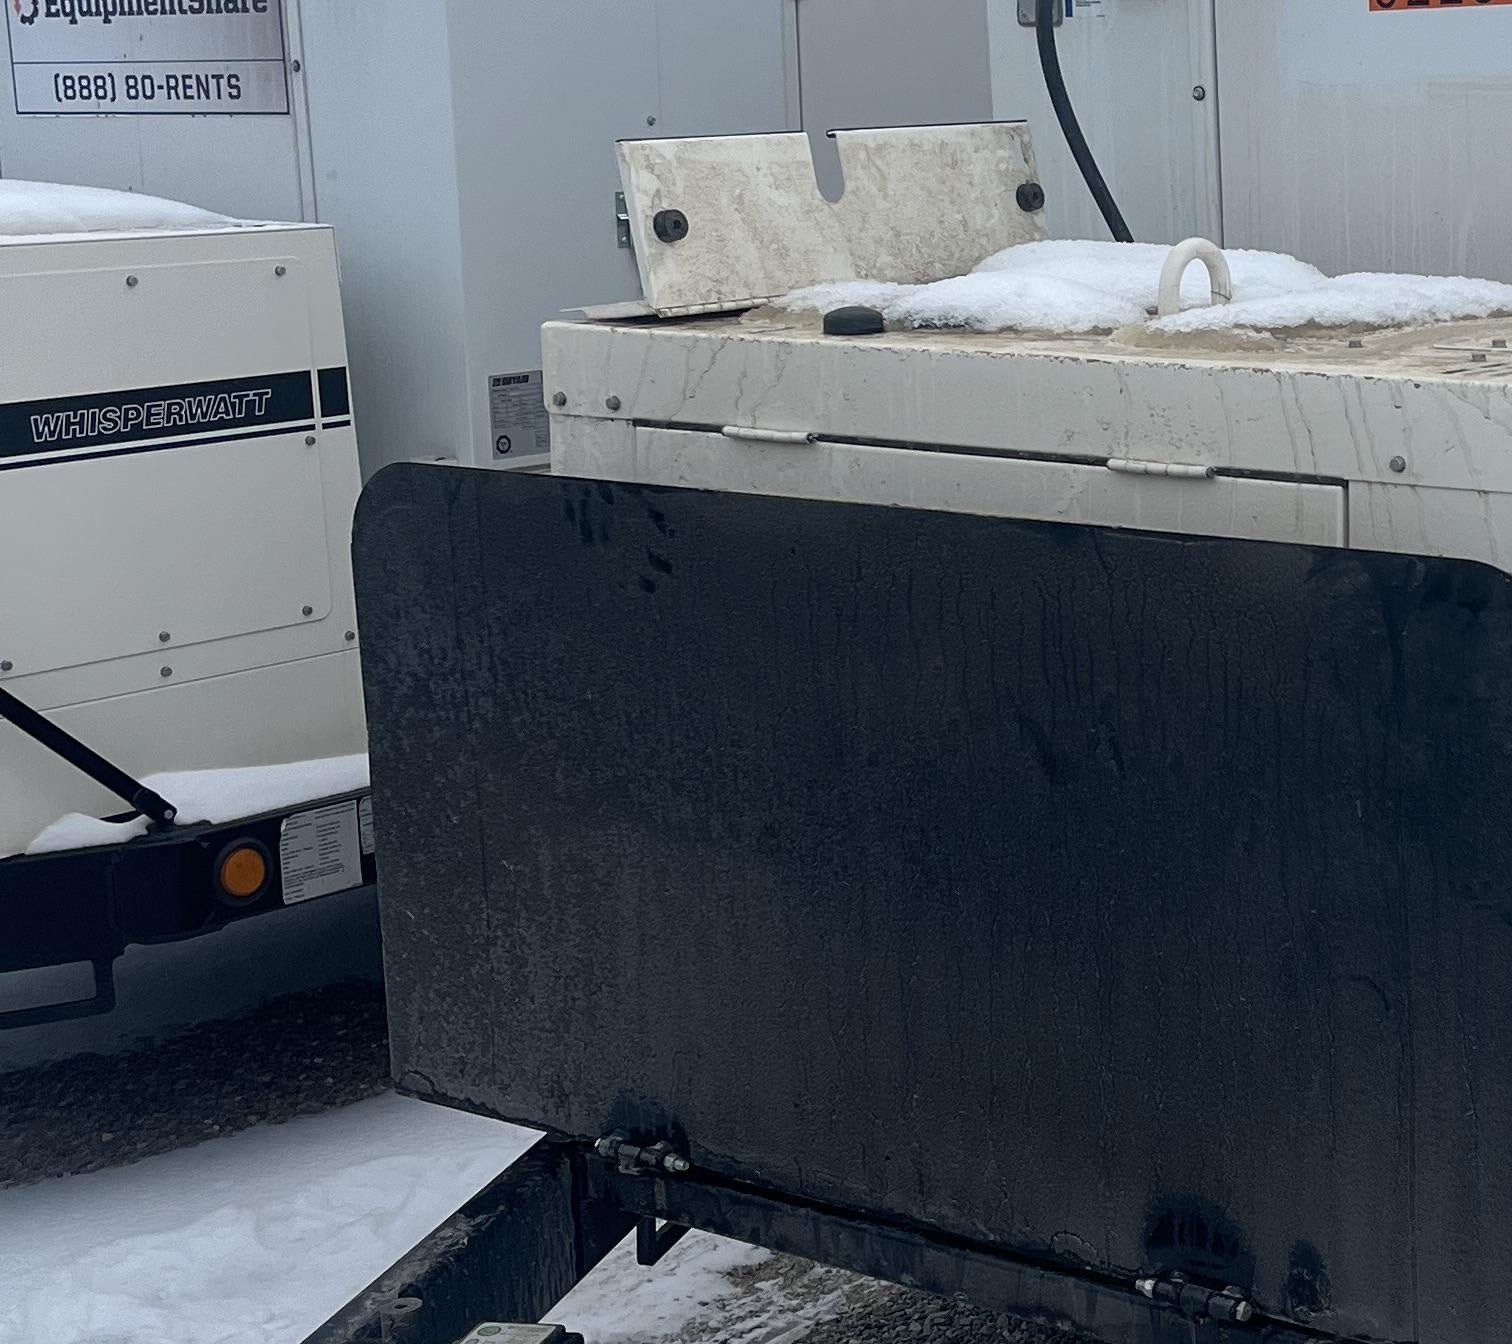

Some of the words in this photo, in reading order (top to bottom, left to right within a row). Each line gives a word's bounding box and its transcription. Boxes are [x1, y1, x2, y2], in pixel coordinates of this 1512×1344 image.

[53, 72, 117, 103] (888)
[125, 73, 242, 101] 80-RENTS
[30, 388, 272, 443] WHISPERWATT
